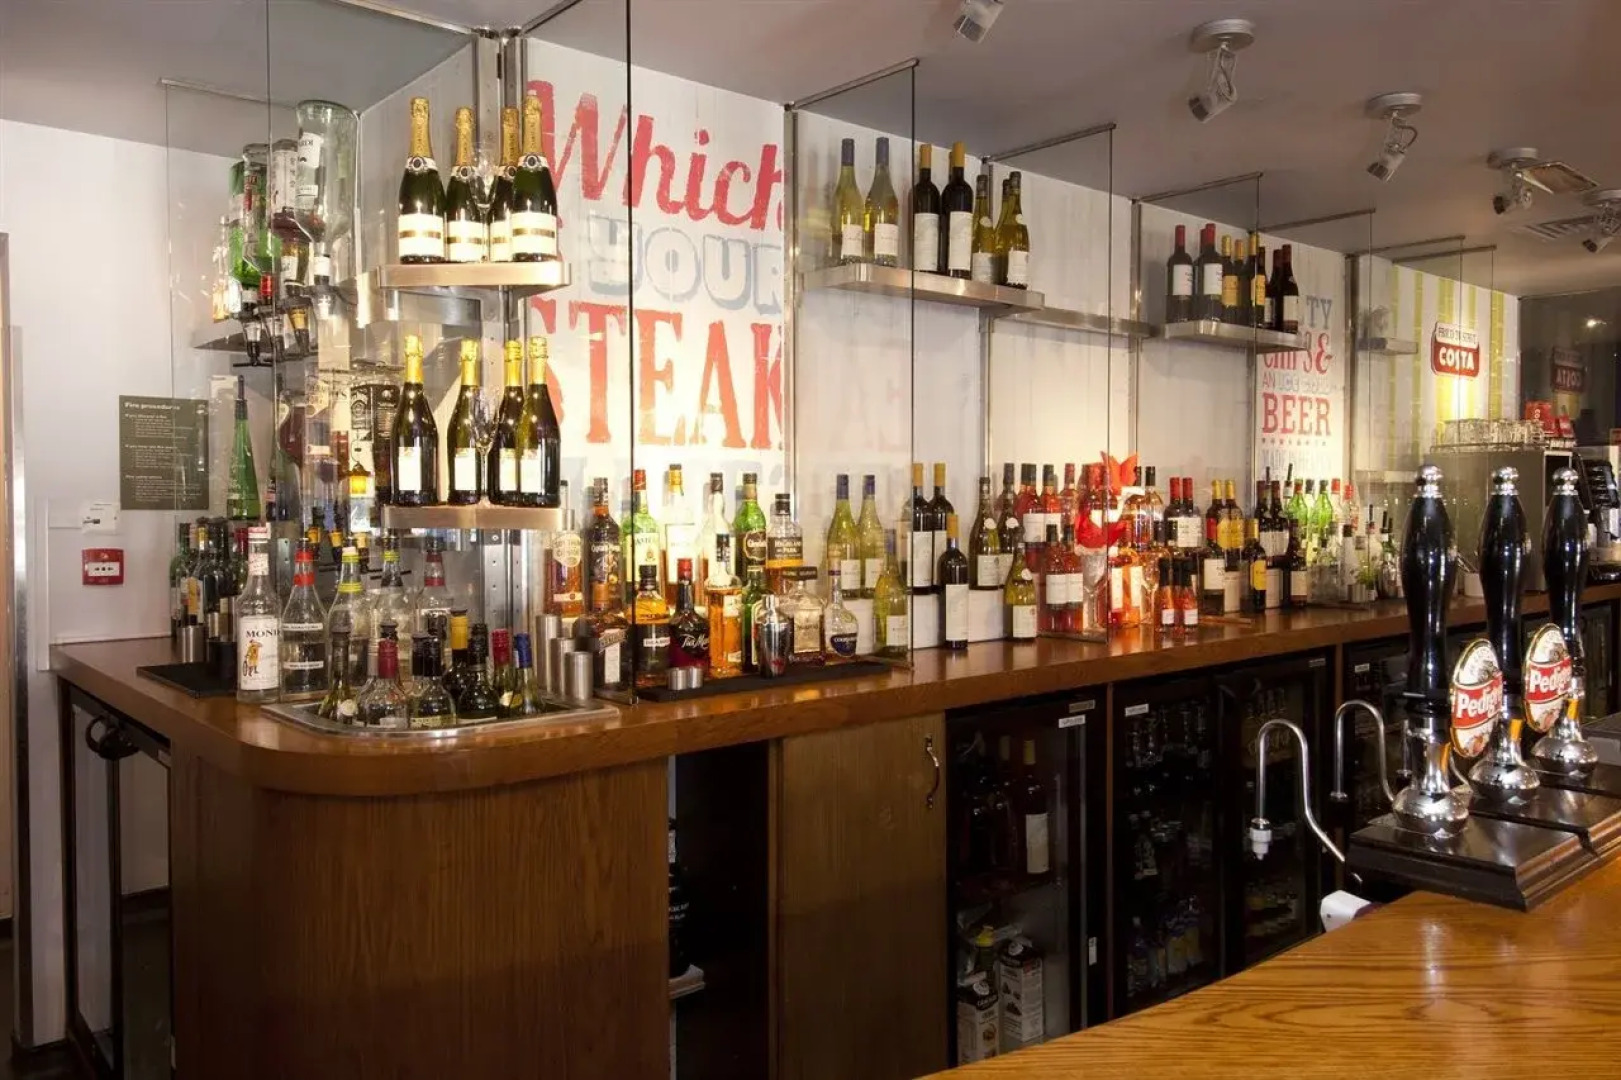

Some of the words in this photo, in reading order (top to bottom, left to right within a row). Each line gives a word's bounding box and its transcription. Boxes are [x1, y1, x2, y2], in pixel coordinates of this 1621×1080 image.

[1439, 346, 1475, 370] COSTA
[1262, 392, 1331, 436] BEER
[1529, 665, 1572, 695] Pedig
[1456, 685, 1503, 719] Pedig
